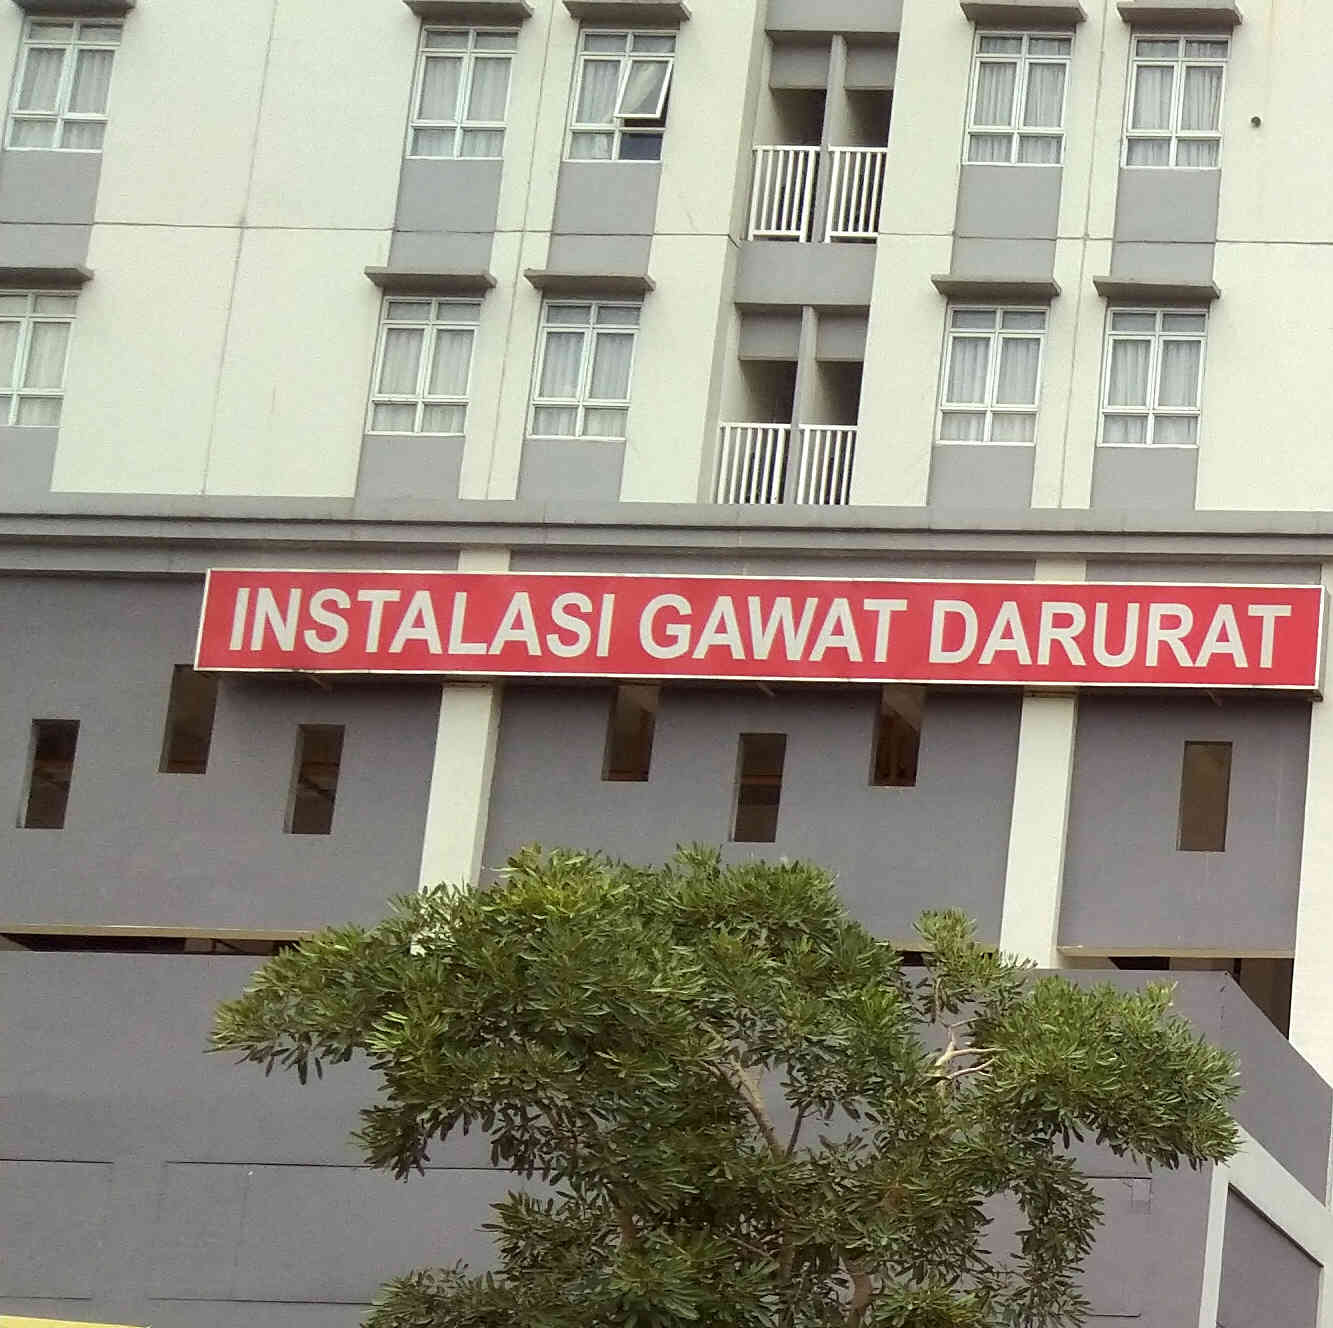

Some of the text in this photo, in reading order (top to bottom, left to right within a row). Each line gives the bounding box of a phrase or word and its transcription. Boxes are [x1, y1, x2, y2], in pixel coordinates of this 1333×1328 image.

[228, 586, 1293, 669] INSTALASI GAWAT DARURAT
